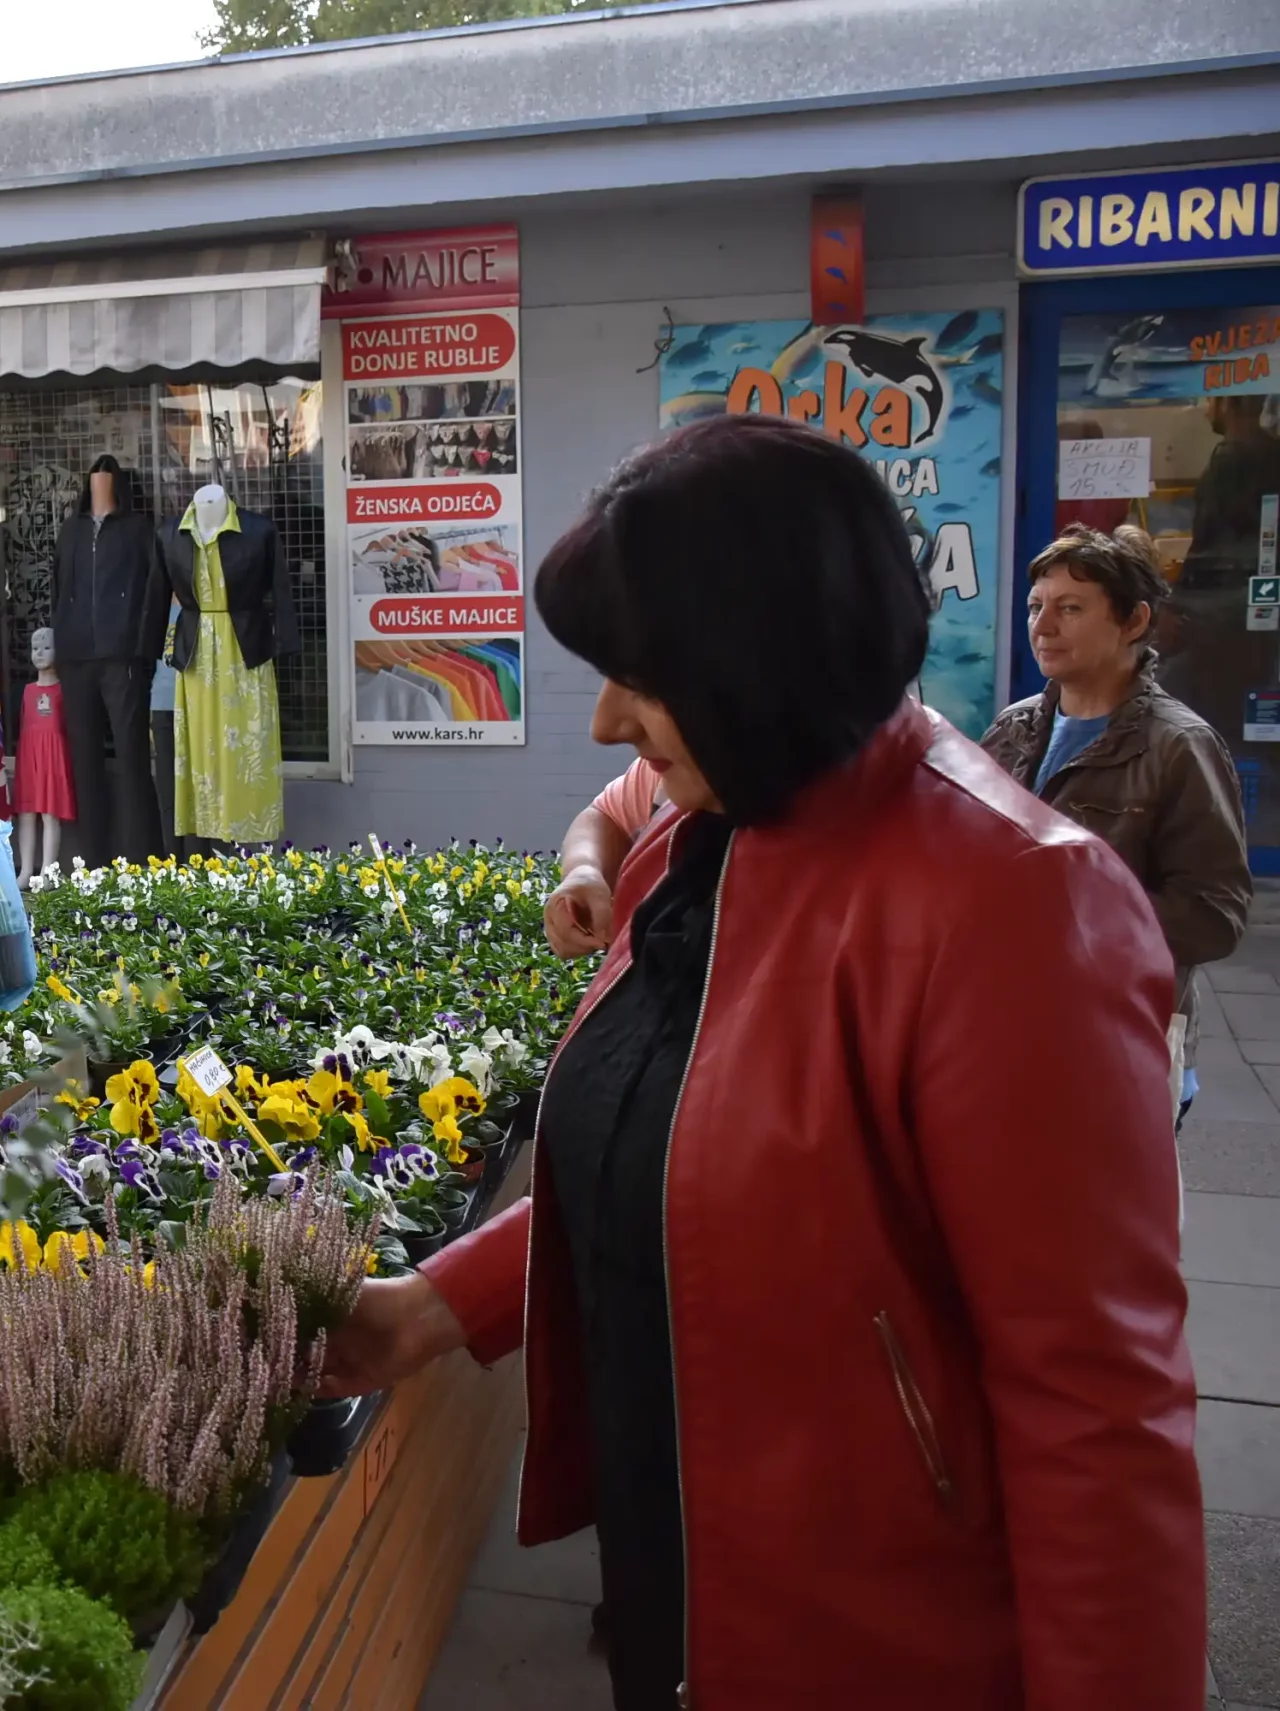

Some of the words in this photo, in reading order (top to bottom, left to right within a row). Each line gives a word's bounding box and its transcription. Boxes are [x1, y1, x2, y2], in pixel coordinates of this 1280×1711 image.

[1038, 182, 1280, 250] RIBARNI
[381, 245, 499, 291] MAJICE
[350, 323, 478, 349] KVALITETNO
[350, 351, 418, 373] DONJE
[424, 346, 500, 369] RUBLJE
[1204, 353, 1270, 391] RIBA
[726, 360, 912, 450] Orka
[355, 495, 423, 516] ŽENSKA
[427, 491, 496, 513] ODJEĆA
[378, 606, 444, 627] MUŠKE
[449, 607, 517, 626] MAJICE
[392, 727, 484, 740] www.kars.hr
